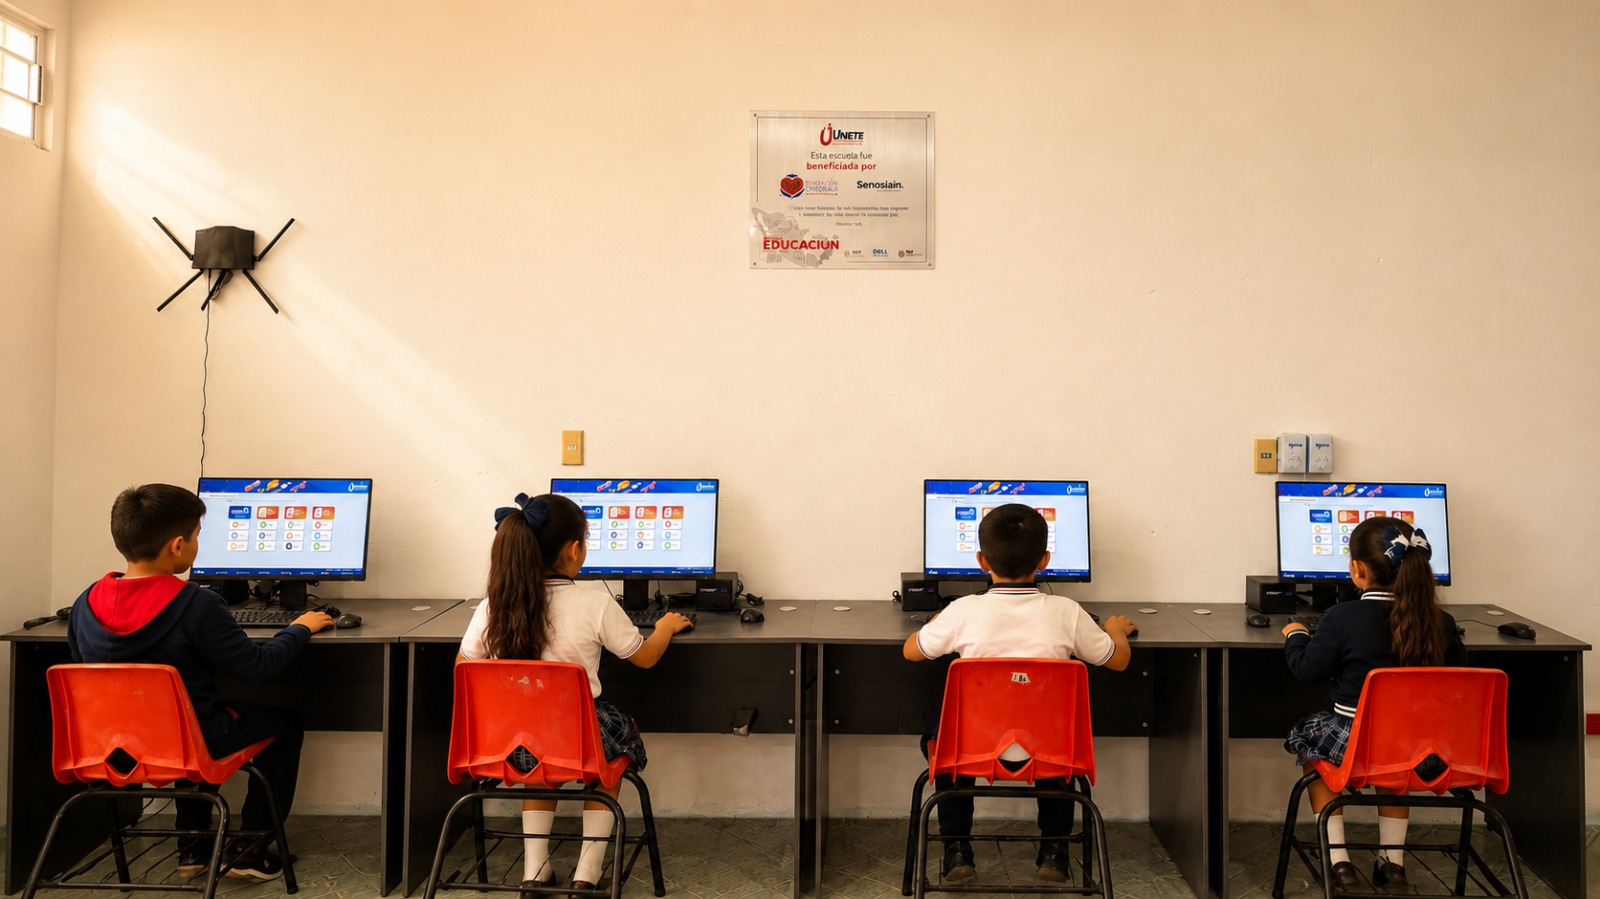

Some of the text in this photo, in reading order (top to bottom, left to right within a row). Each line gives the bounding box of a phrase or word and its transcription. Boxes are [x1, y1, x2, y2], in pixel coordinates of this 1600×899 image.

[833, 129, 864, 140] UNETE
[810, 151, 827, 160] Esta
[859, 151, 873, 160] fue
[806, 162, 877, 171] beneficiada por
